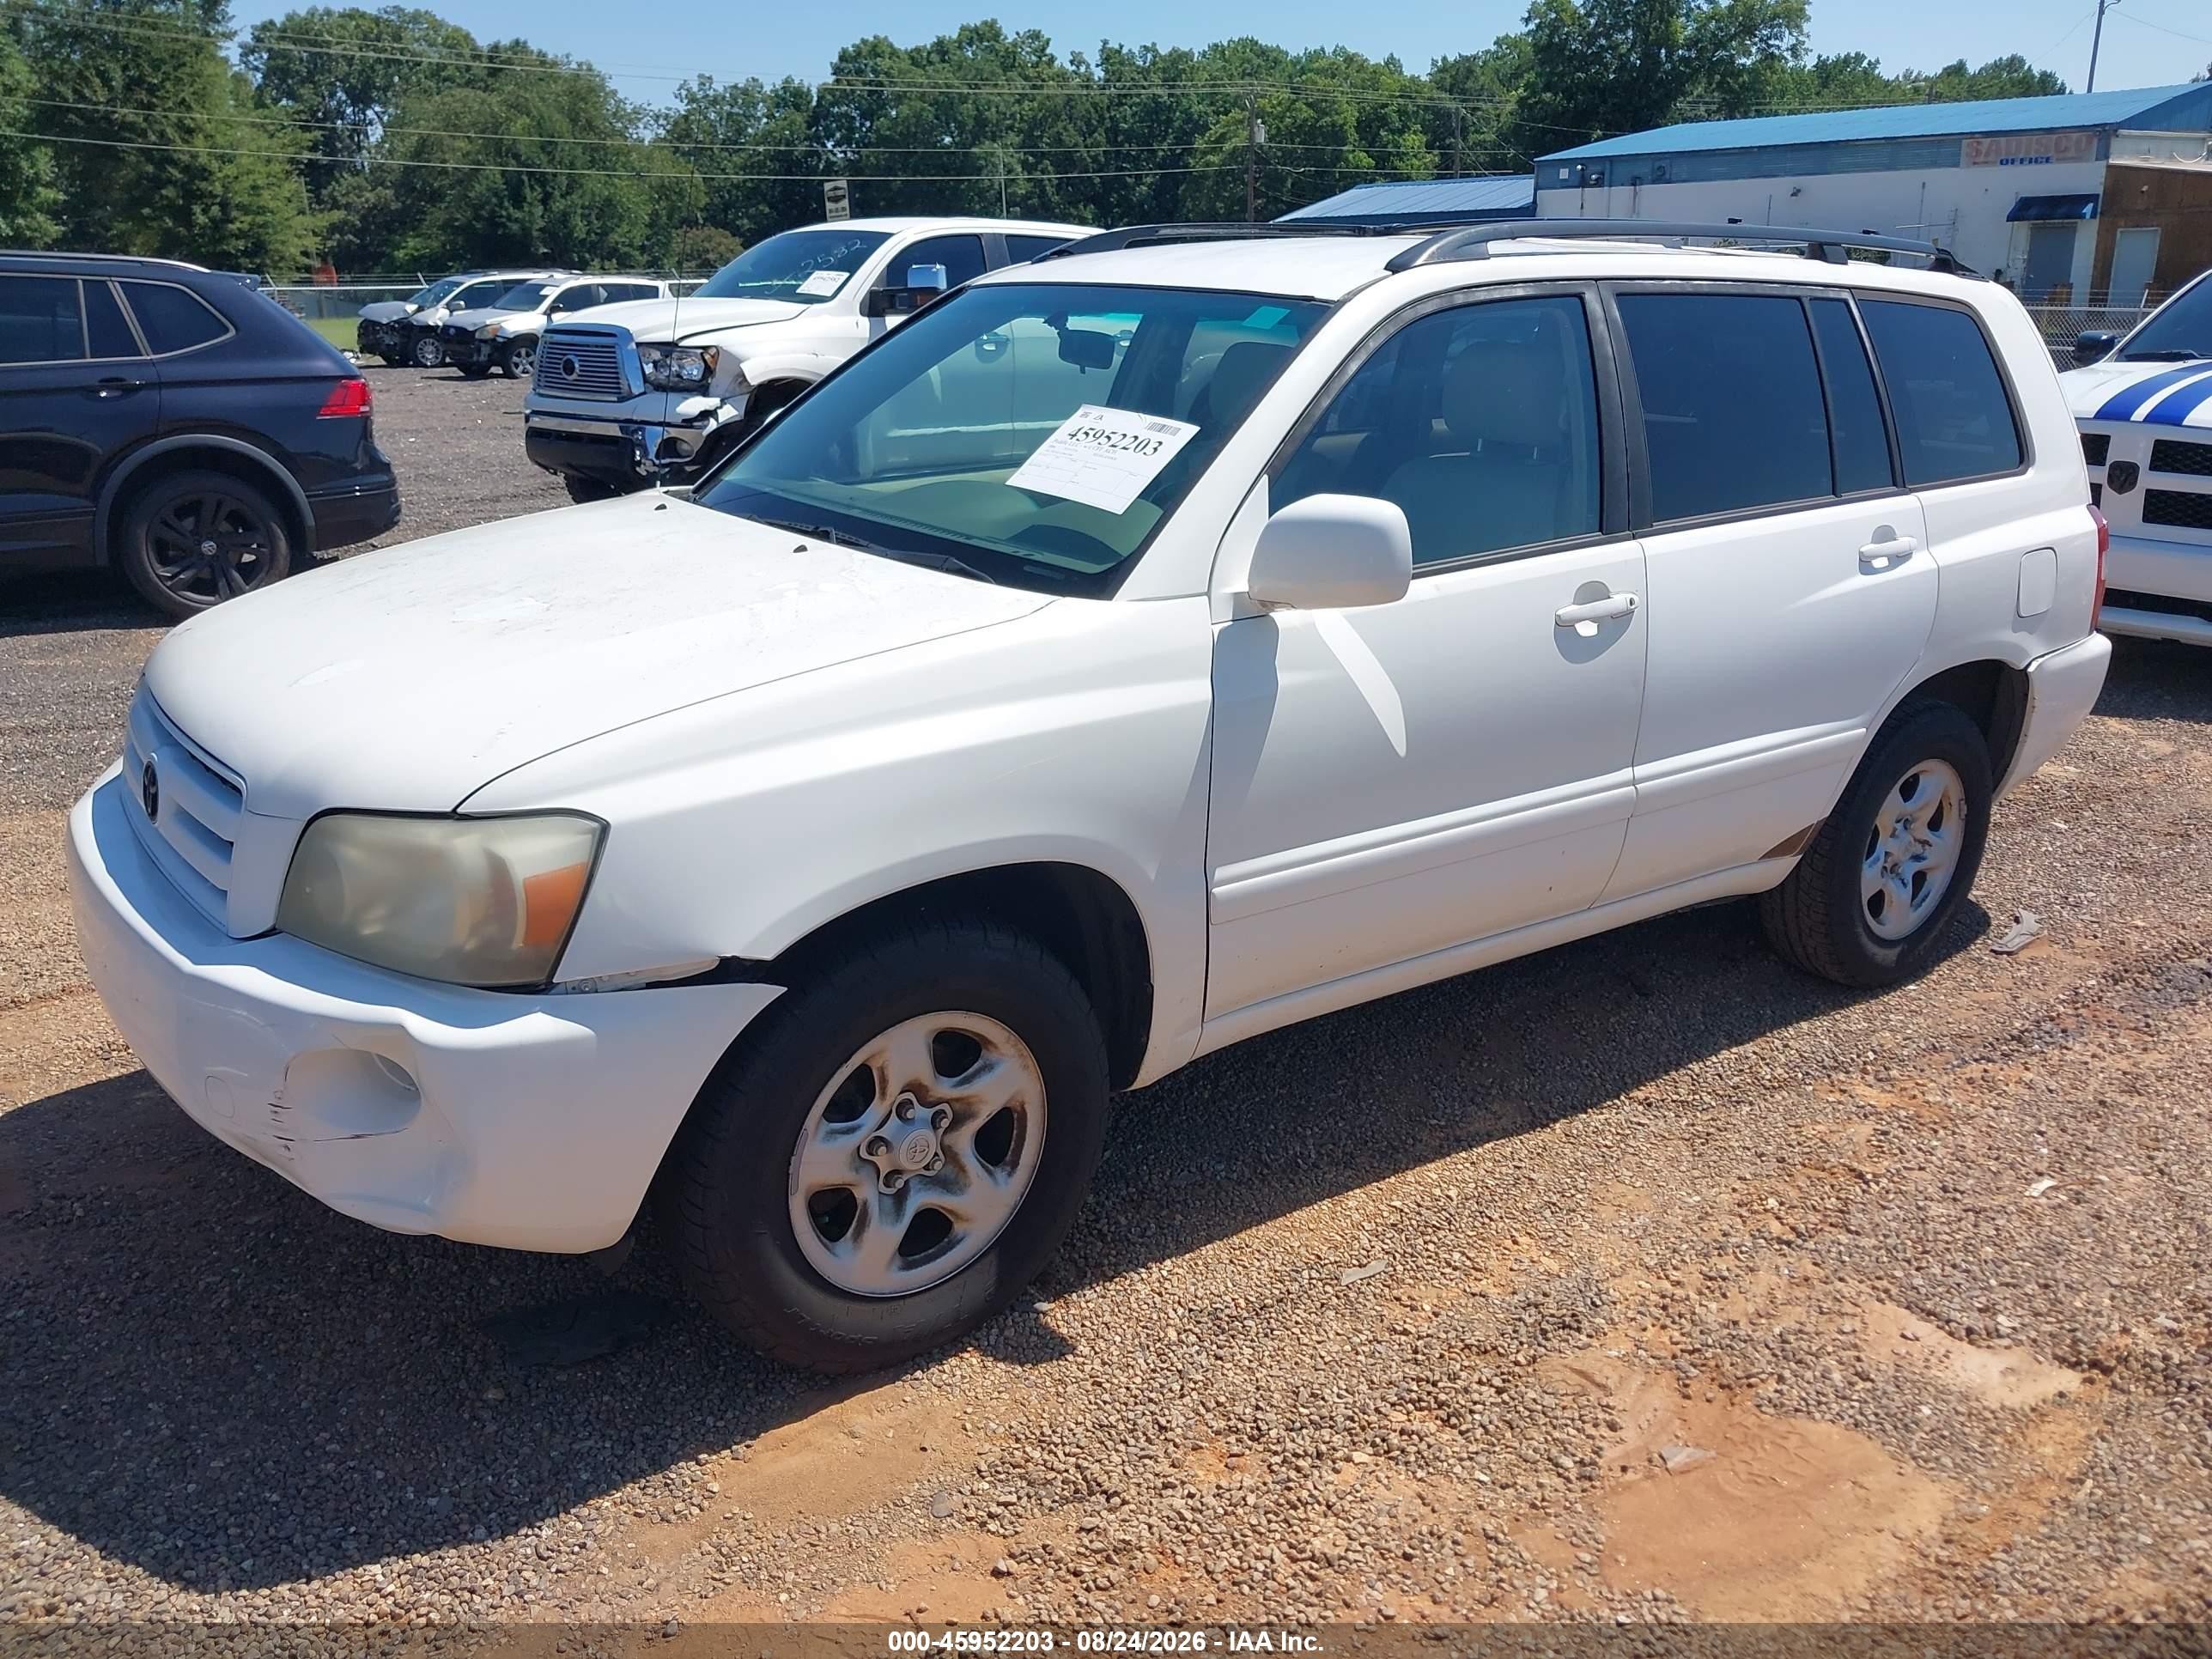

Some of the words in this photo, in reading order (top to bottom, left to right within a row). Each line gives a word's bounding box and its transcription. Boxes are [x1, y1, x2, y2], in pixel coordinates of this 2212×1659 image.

[1967, 135, 2094, 158] SADISCO
[1999, 156, 2053, 166] OFFICE
[1067, 426, 1163, 457] 45952203
